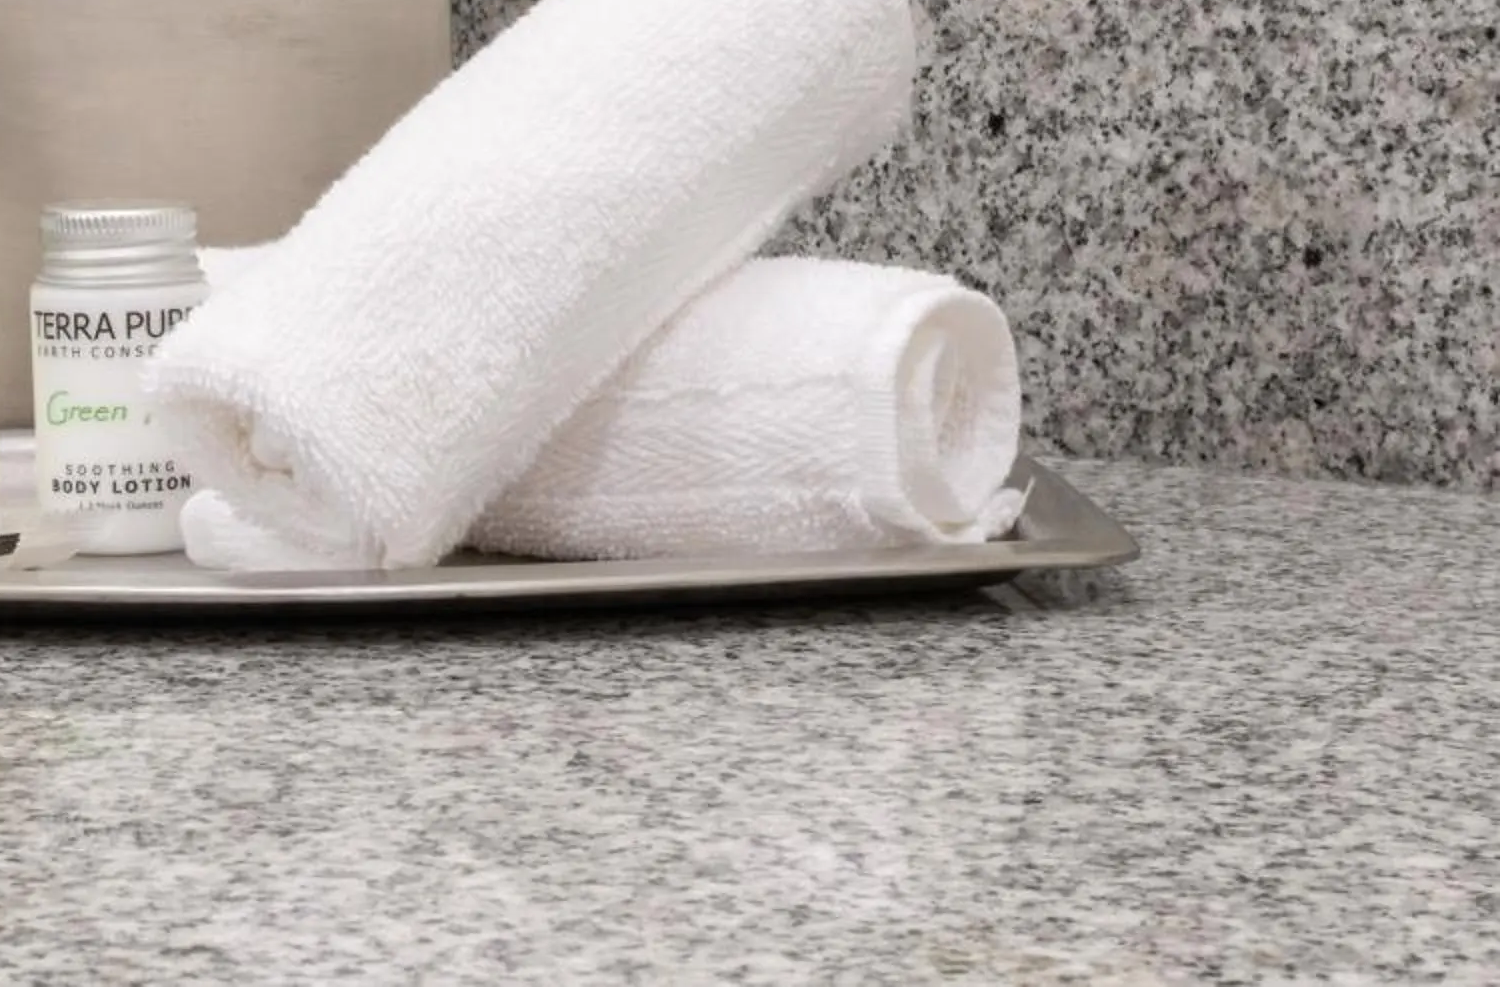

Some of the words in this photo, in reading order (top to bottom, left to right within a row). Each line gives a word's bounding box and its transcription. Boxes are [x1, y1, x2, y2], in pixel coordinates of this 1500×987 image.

[34, 311, 116, 341] TERRA
[126, 307, 192, 339] PUR
[46, 390, 128, 426] Green
[65, 460, 176, 476] SOOTHING
[52, 478, 100, 495] BODY
[112, 474, 191, 495] LOTION
